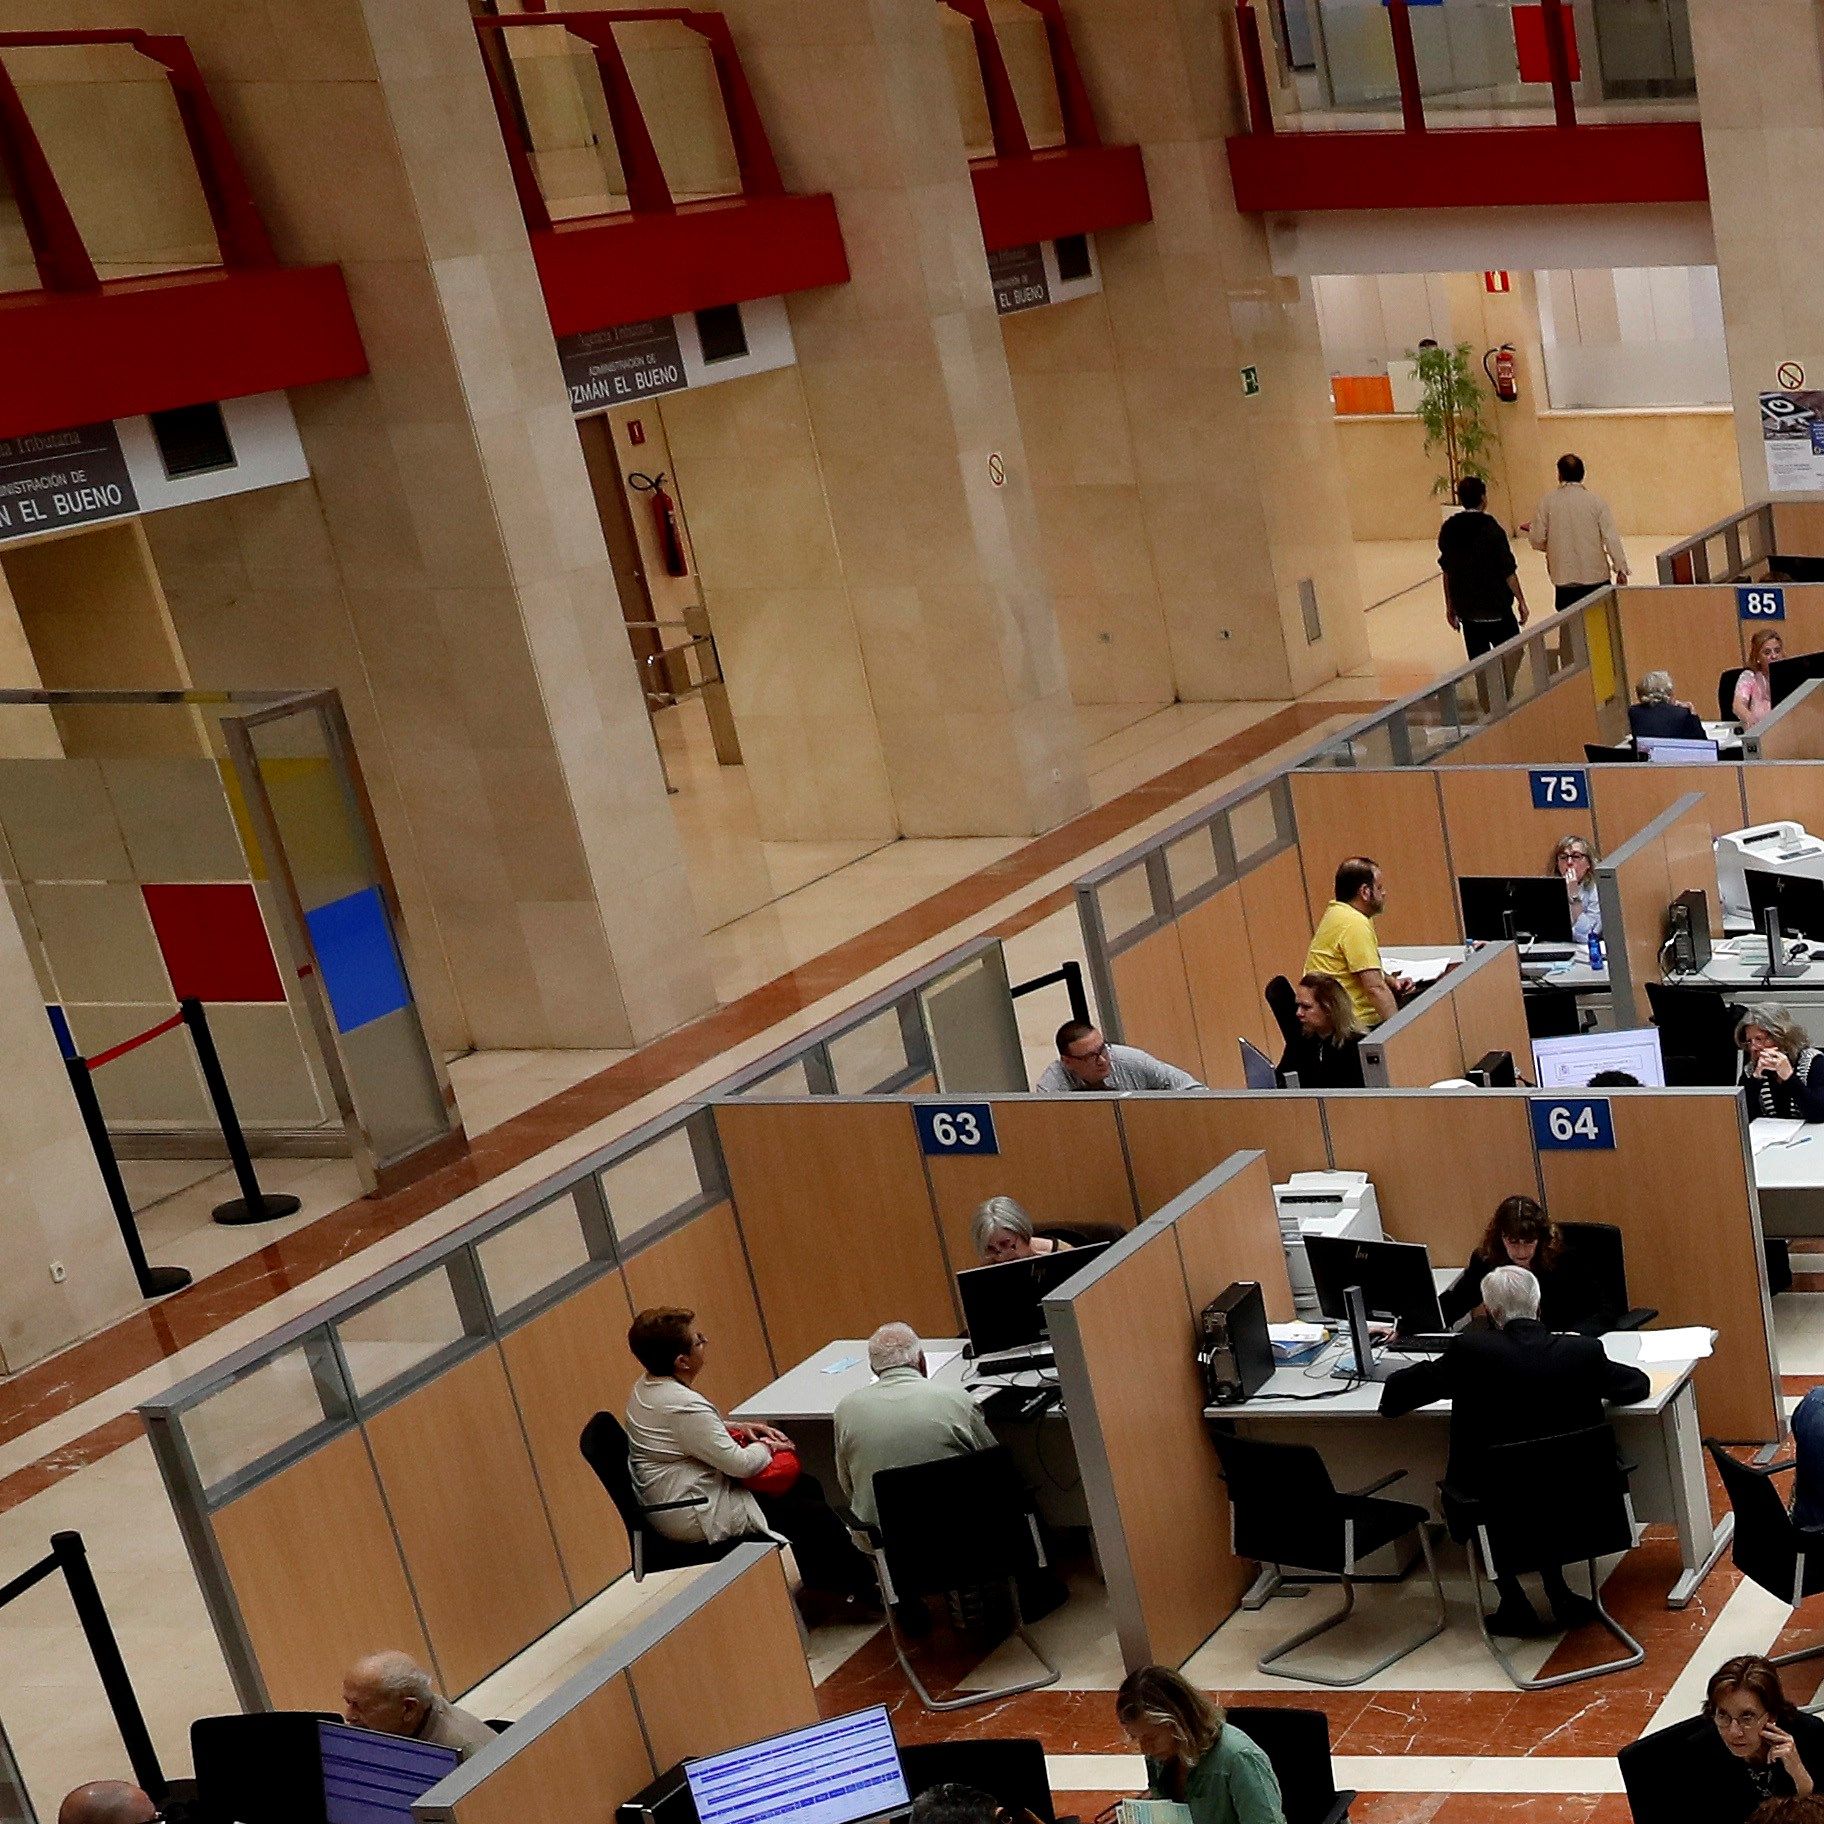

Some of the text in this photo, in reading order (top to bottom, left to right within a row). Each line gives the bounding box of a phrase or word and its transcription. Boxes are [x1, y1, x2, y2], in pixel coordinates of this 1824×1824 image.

[568, 365, 679, 404] ZMÁN EL BUENO
[72, 470, 88, 484] DE
[20, 499, 48, 523] EL
[54, 483, 123, 516] BUENO
[1748, 593, 1776, 614] 85
[1541, 777, 1577, 801] 75
[933, 1113, 980, 1145] 63
[1550, 1107, 1598, 1140] 64
